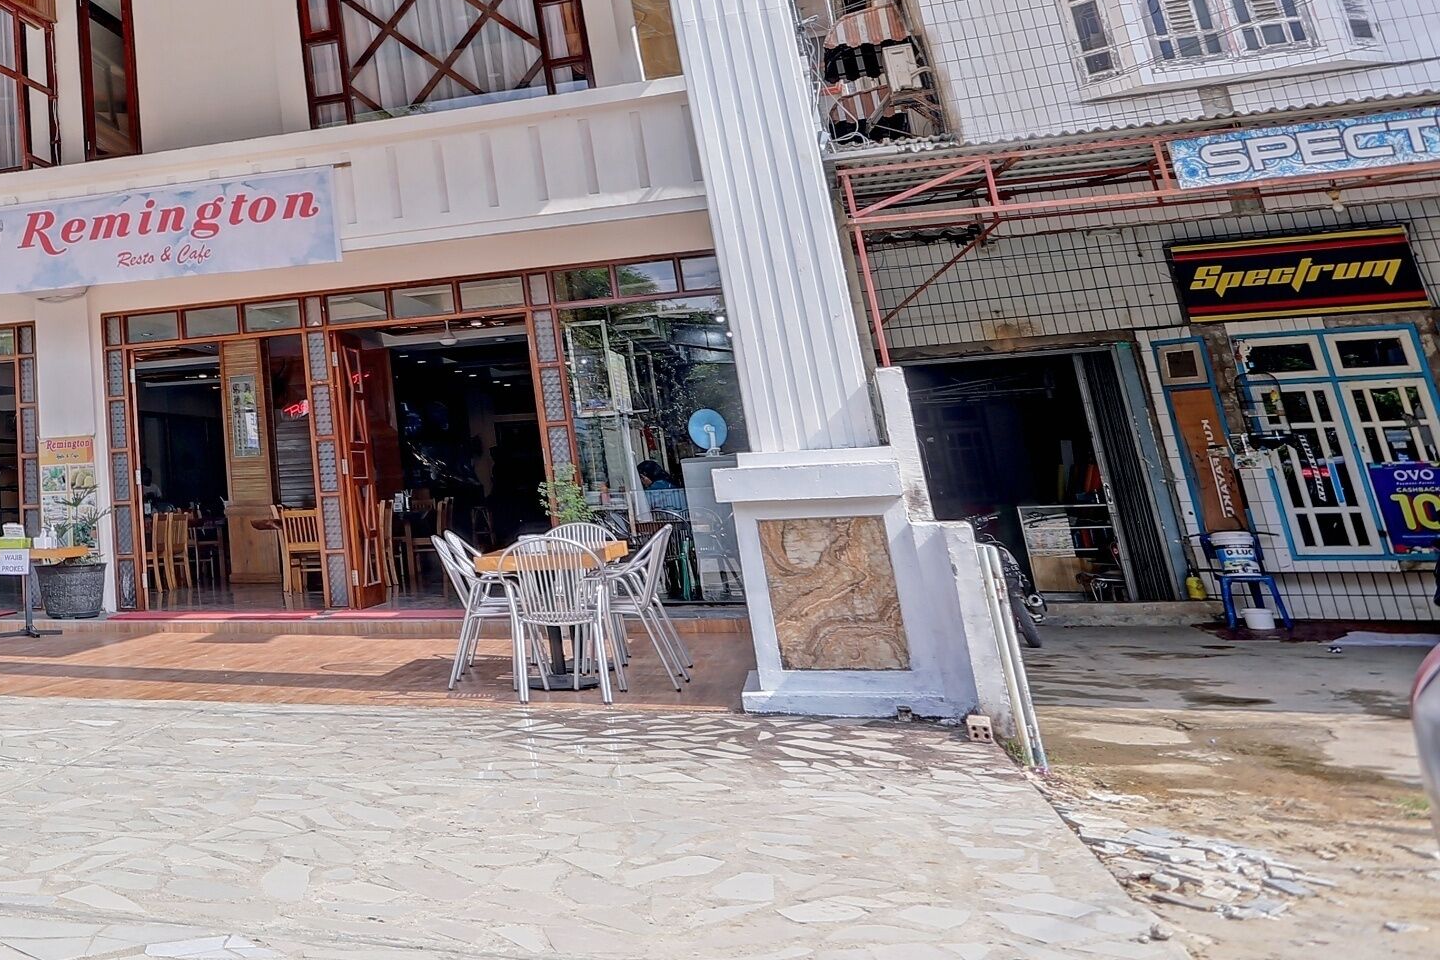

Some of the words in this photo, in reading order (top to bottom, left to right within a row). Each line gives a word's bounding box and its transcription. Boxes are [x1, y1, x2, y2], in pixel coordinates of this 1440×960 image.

[1200, 117, 1440, 176] SPECT
[17, 191, 319, 256] Remington
[117, 251, 154, 267] Resto
[161, 246, 171, 262] &
[177, 244, 211, 264] Cafe
[1190, 258, 1401, 298] Spectrum
[45, 439, 90, 452] Remington
[1394, 469, 1434, 481] OVO
